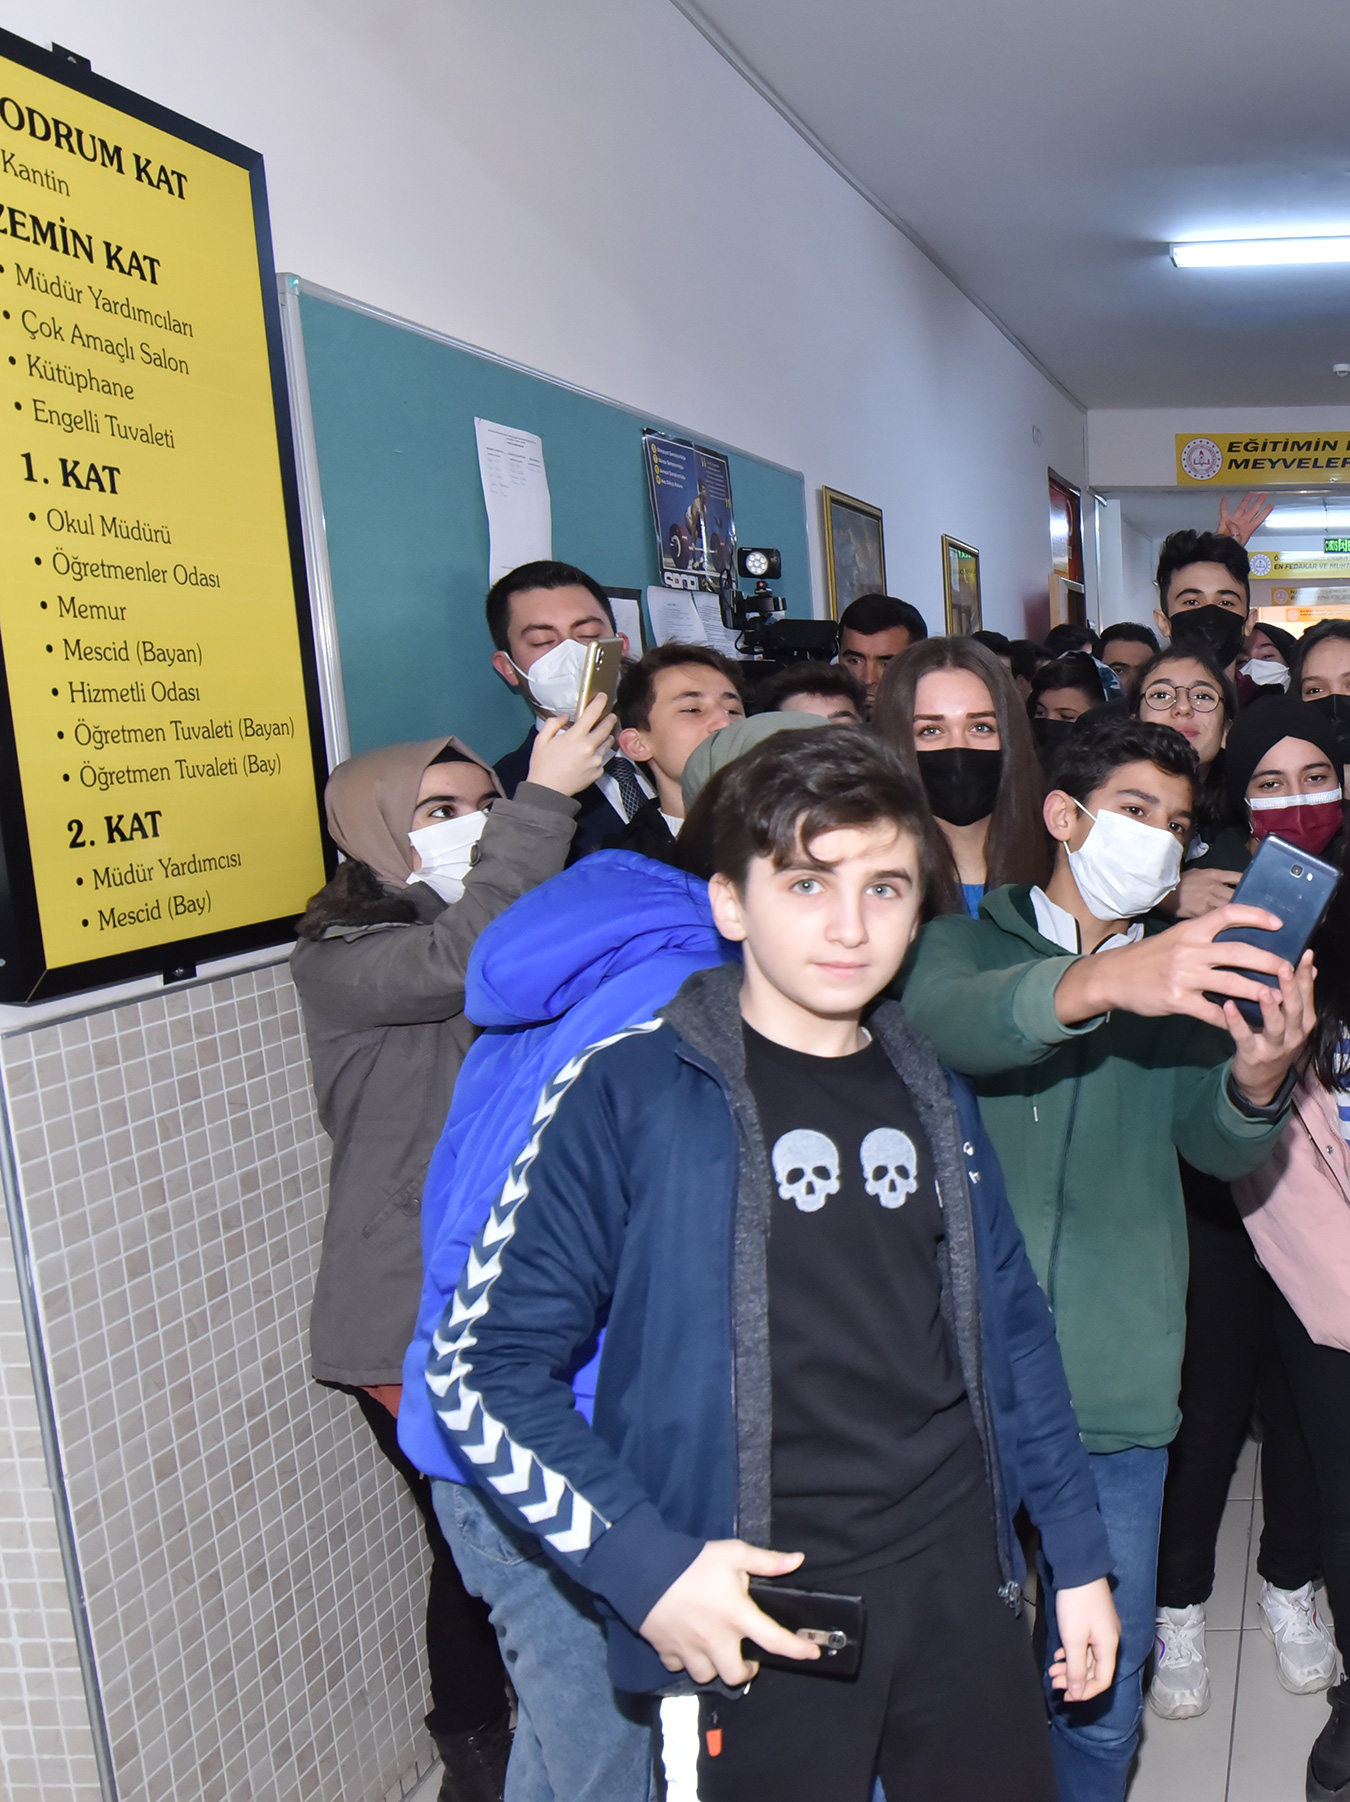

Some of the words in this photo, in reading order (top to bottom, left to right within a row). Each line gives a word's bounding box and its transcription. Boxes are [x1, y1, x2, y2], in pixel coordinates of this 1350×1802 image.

[1, 148, 71, 198] Kantin
[132, 152, 189, 200] KAT
[103, 240, 161, 286] KAT
[15, 262, 83, 305] Müdür
[87, 285, 194, 339] Yardımcıları
[21, 309, 65, 343] Çok
[70, 327, 135, 366] Amaçlı
[139, 342, 190, 376] Salon
[26, 353, 135, 402] Kütüphane
[32, 398, 100, 435] Engelli
[104, 414, 175, 449] Tuvaleti
[1227, 438, 1339, 453] EĞİTİMİN
[20, 451, 49, 486] 1.
[58, 457, 121, 495] KAT
[46, 506, 95, 536] Okul
[100, 513, 172, 545] Müdürü
[52, 546, 168, 585] Öğretmenler
[173, 563, 221, 589] Odası
[58, 595, 127, 622] Memur
[63, 636, 130, 664] Mescid
[135, 639, 203, 667] (Bayan)
[68, 681, 146, 704] Hizmetli
[151, 680, 201, 703] Odası
[74, 719, 166, 753] Öğretmen
[170, 718, 234, 742] Tuvaleti
[238, 716, 295, 743] (Bayan)
[79, 762, 171, 793] Öğretmen
[175, 757, 238, 781] Tuvaleti
[242, 752, 282, 779] (Bay)
[66, 819, 95, 849] 2.
[104, 810, 163, 845] KAT
[92, 865, 154, 891] Müdür
[158, 852, 242, 880] Yardımcısı
[98, 901, 162, 931] Mescid
[167, 889, 212, 921] (Bay)
